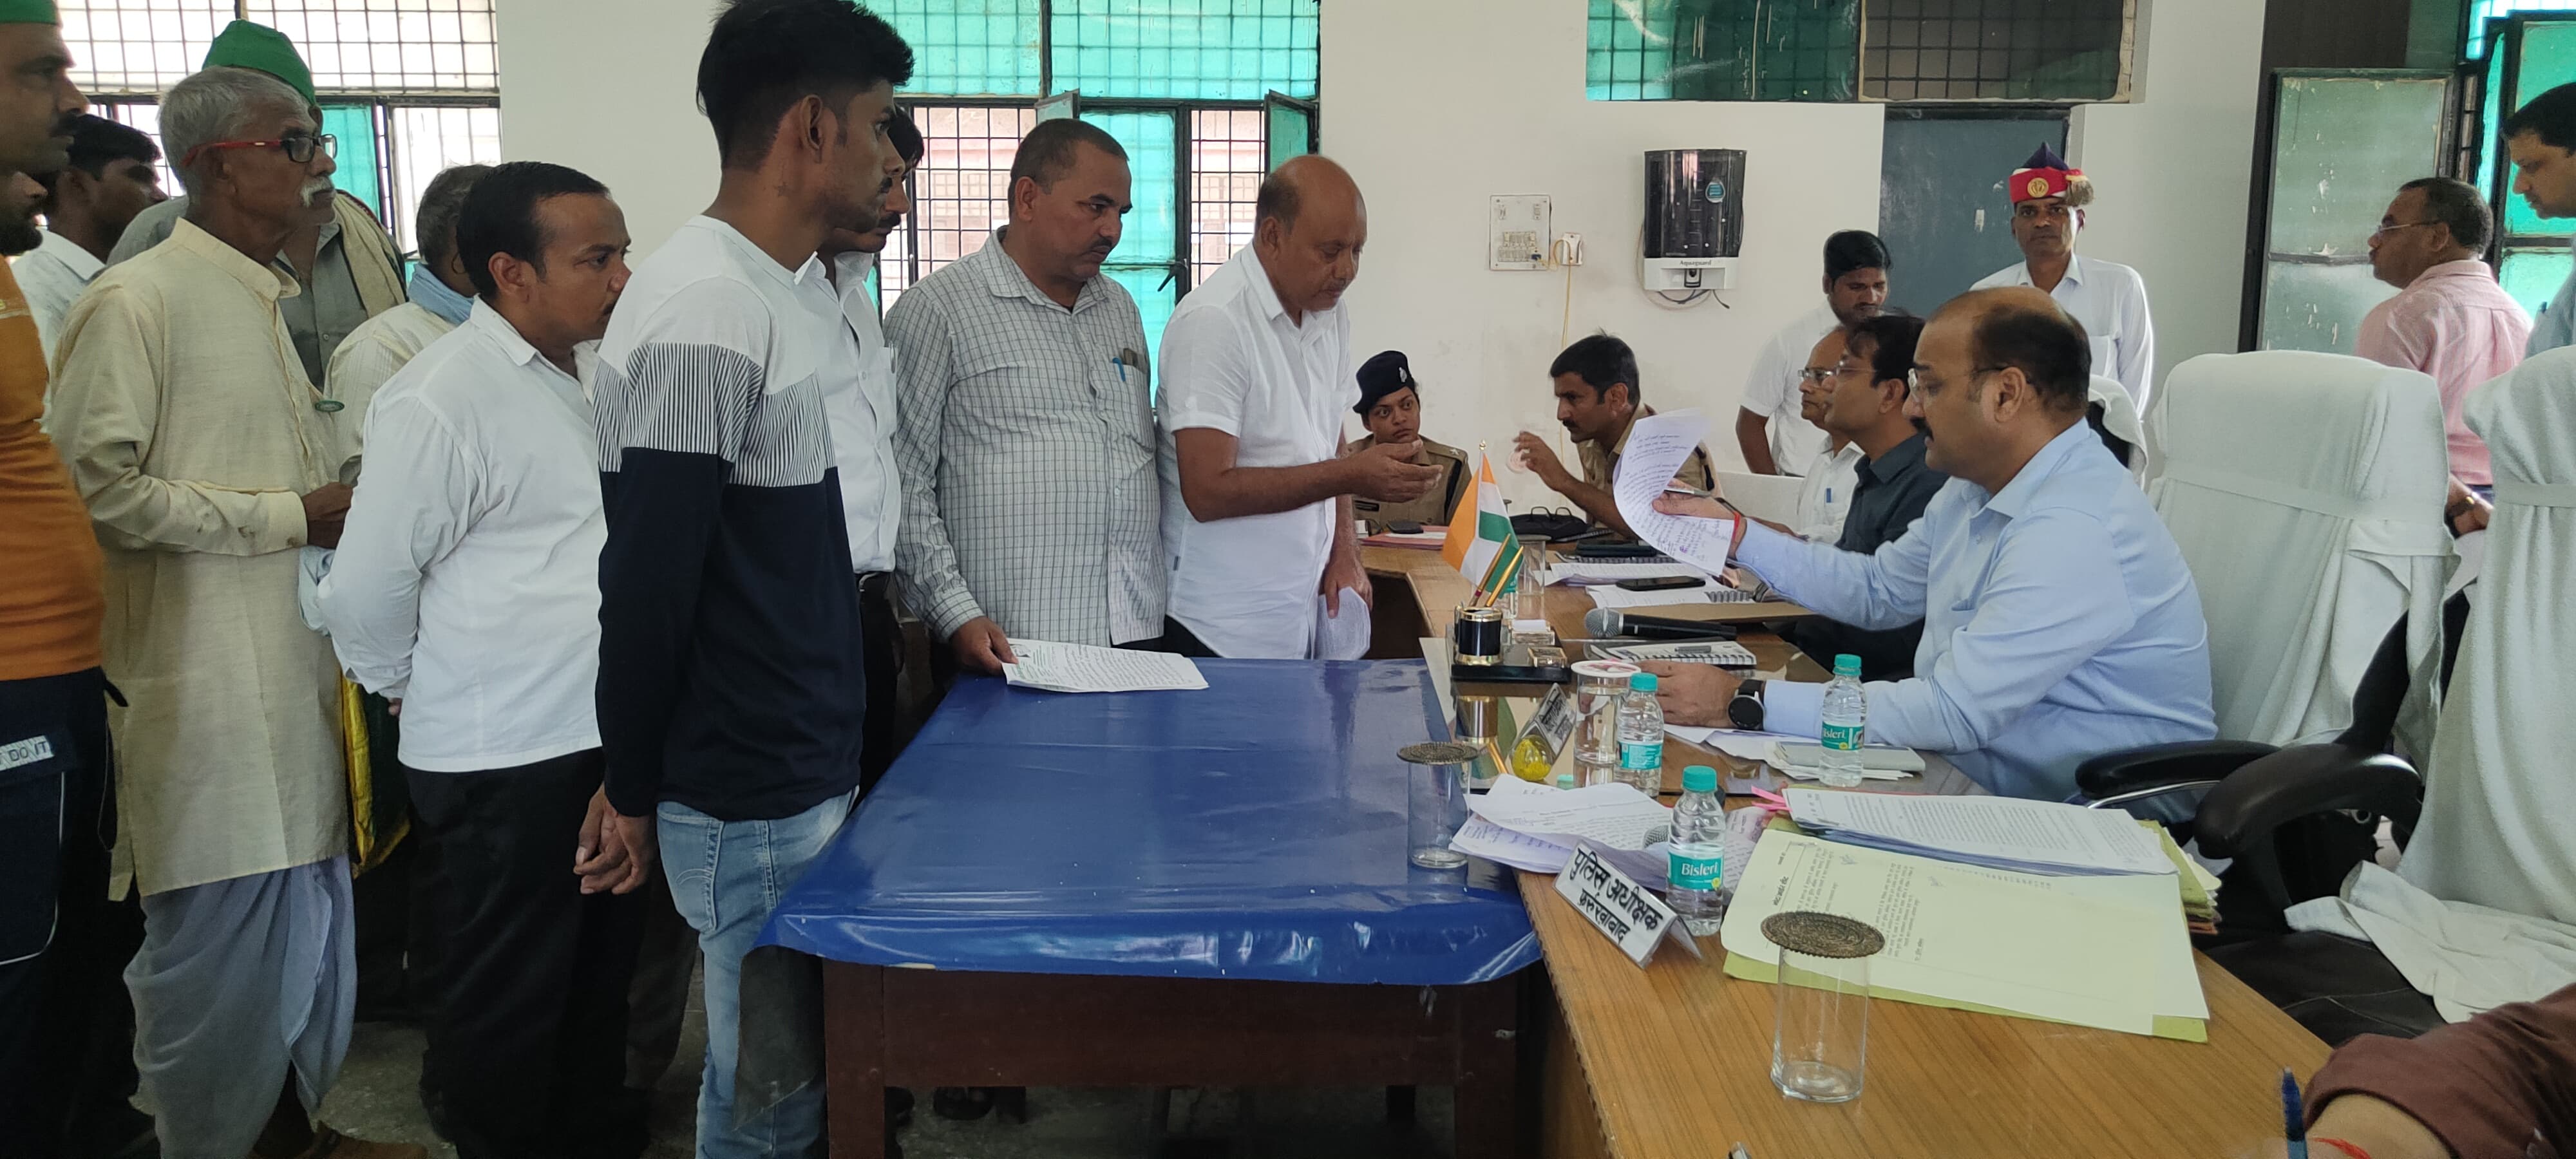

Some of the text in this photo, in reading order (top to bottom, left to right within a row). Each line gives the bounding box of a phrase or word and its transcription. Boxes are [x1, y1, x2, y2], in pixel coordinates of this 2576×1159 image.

[9, 740, 47, 762] DO IT
[1681, 862, 1719, 876] Bisleri
[1569, 847, 1664, 931] पुलिस अधीक्षक
